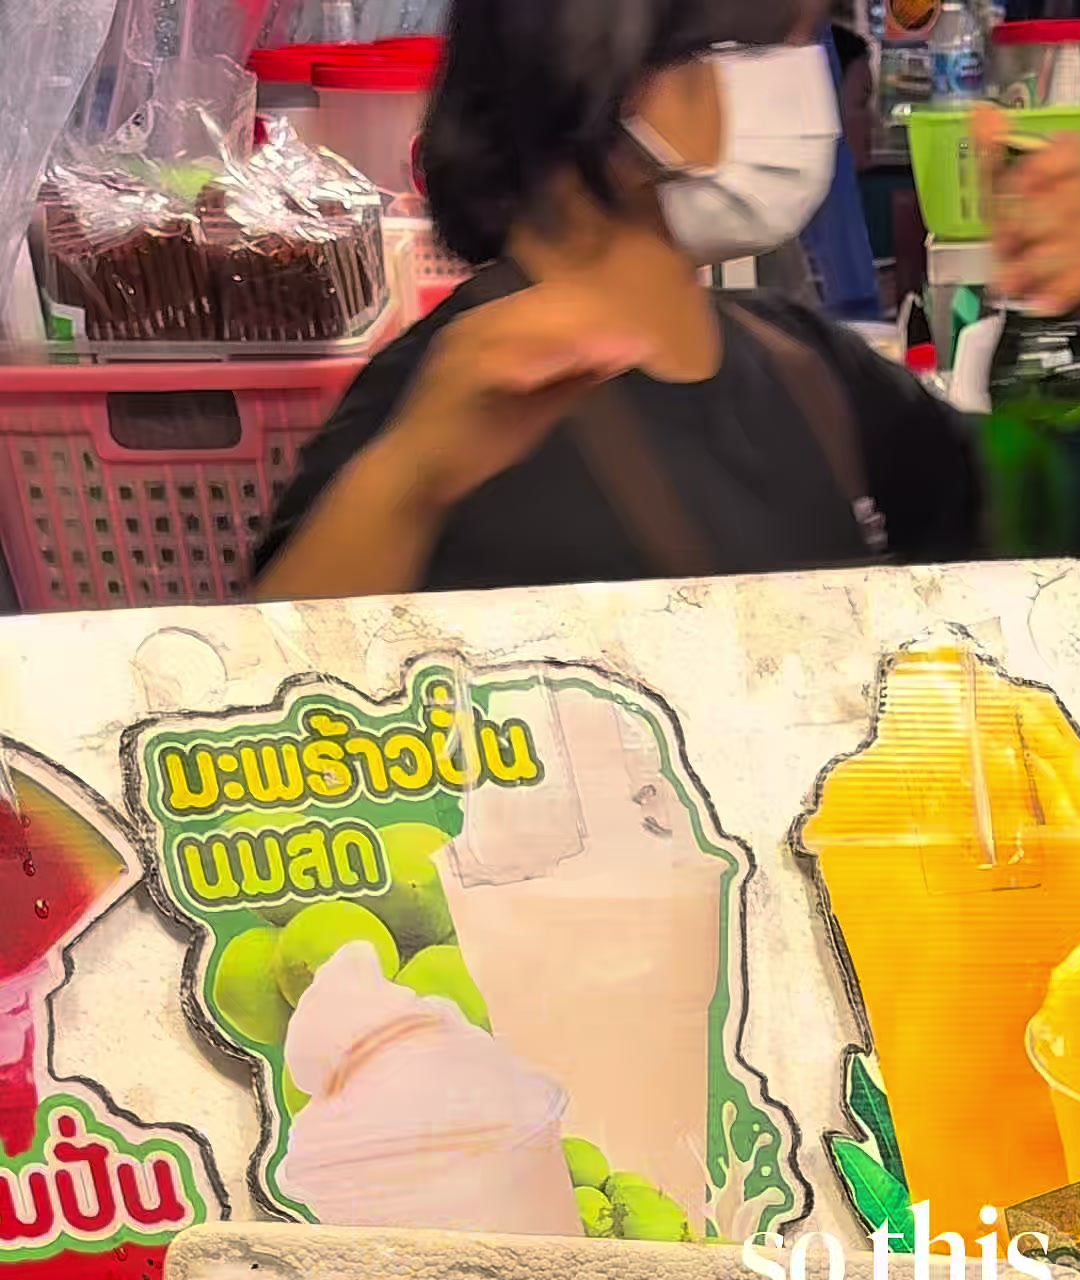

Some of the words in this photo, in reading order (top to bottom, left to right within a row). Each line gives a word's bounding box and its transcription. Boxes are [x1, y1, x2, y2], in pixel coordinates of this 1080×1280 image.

[164, 682, 538, 810] มะพร้าวปั่น
[182, 828, 383, 900] นมสด
